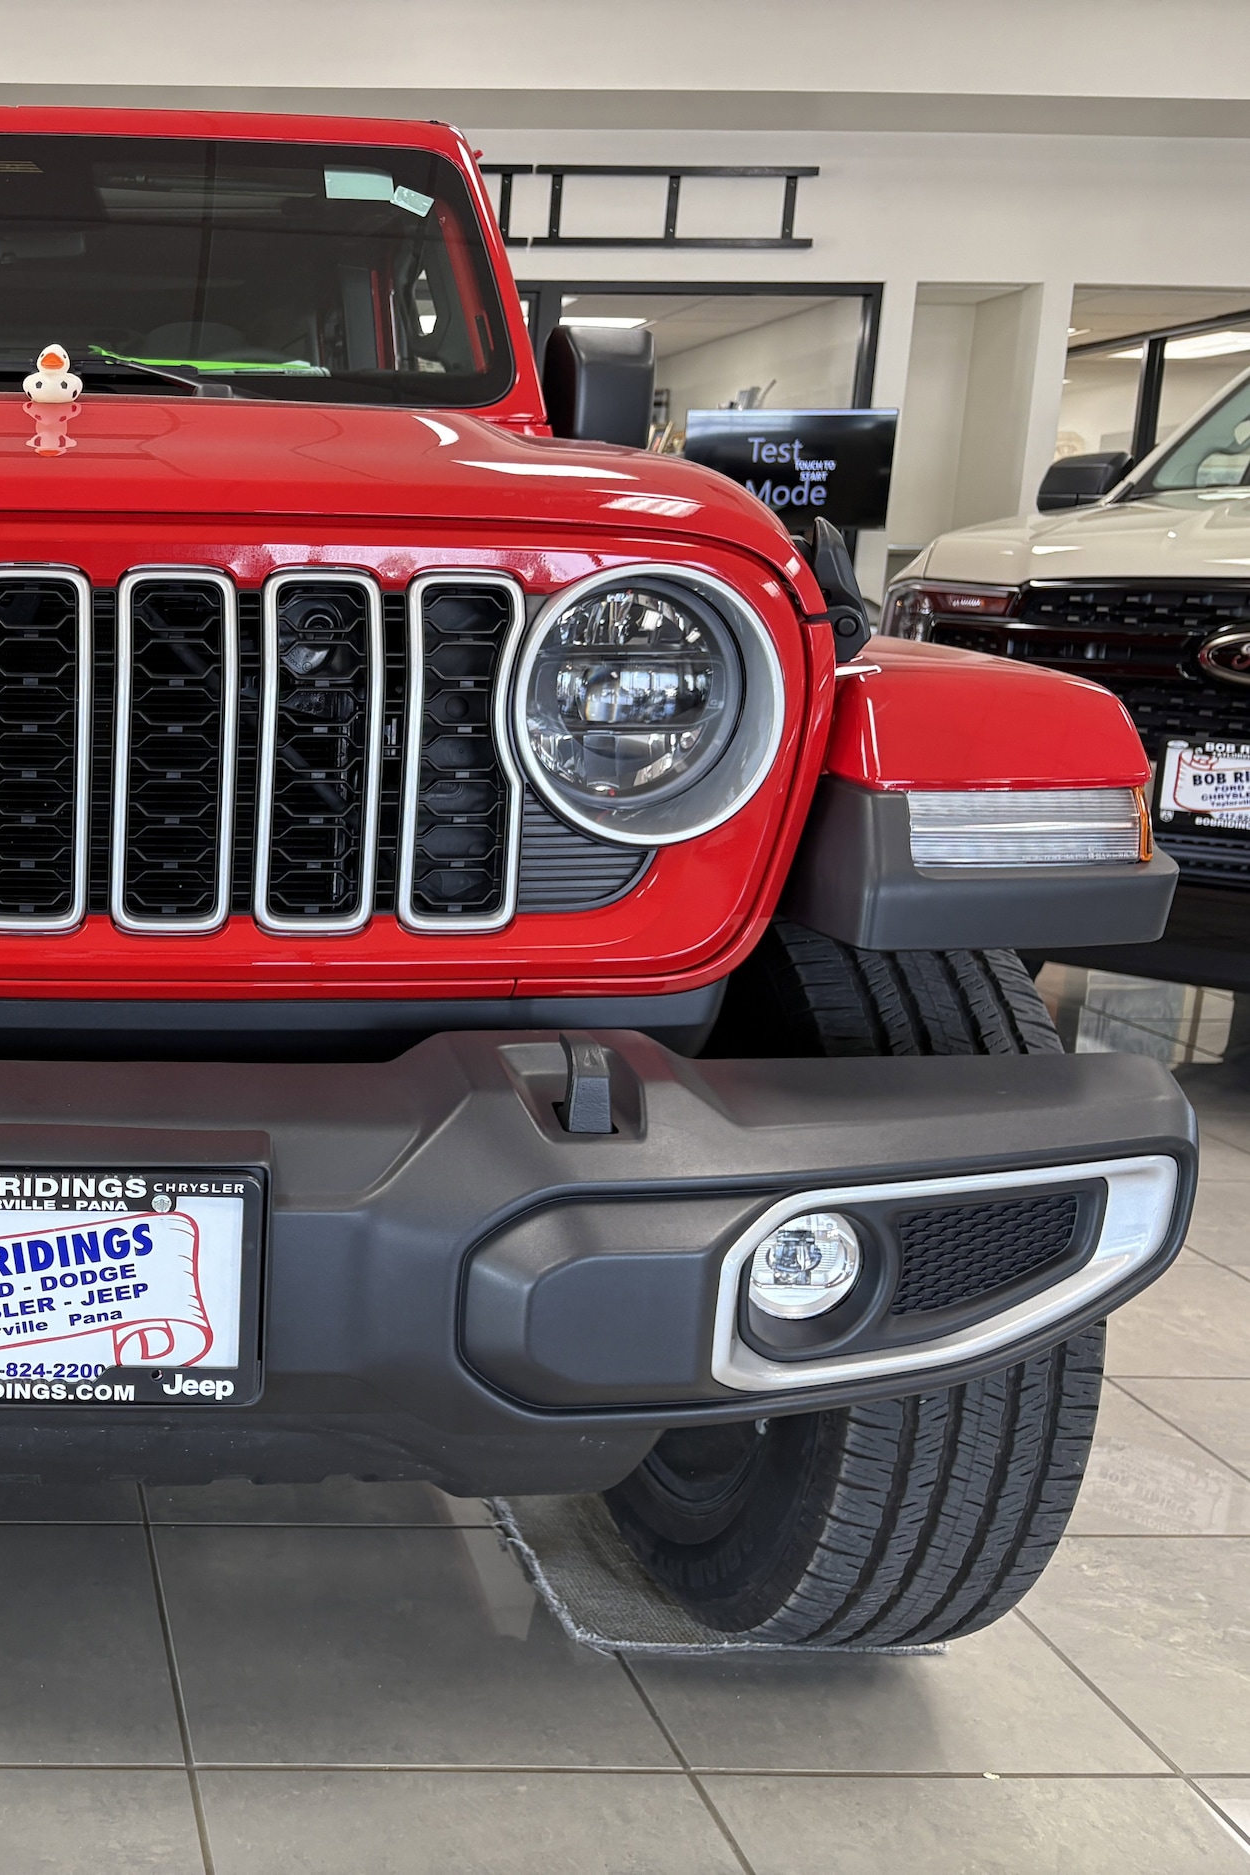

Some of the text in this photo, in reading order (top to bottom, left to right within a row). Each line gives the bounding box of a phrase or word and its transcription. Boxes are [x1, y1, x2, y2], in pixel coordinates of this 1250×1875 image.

[748, 437, 803, 464] Test
[800, 470, 829, 482] START
[745, 478, 827, 506] Mode
[1192, 772, 1227, 787] BOB
[153, 1182, 245, 1194] CHRYSLER
[76, 1200, 129, 1212] PANA
[40, 1263, 137, 1292] DODGE
[80, 1282, 149, 1307] JEEP
[68, 1309, 123, 1327] Pana
[162, 1373, 235, 1401] Jeep
